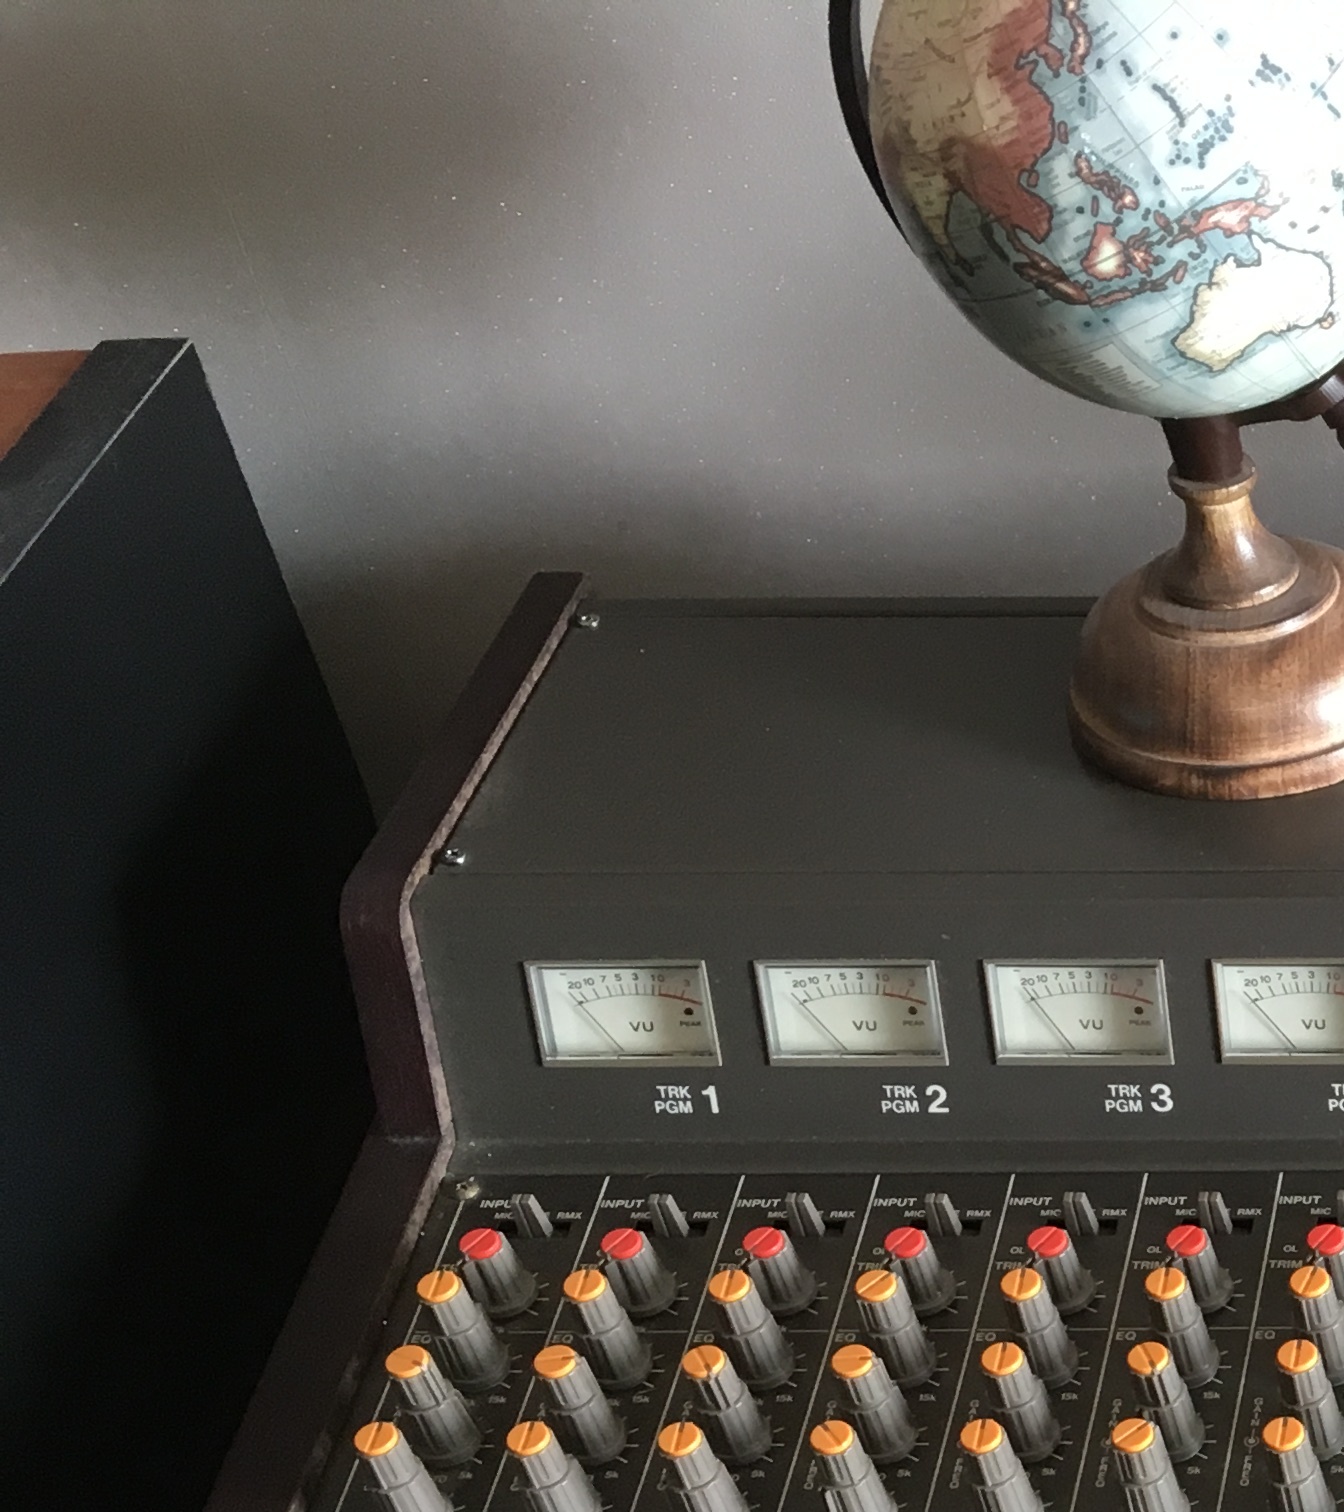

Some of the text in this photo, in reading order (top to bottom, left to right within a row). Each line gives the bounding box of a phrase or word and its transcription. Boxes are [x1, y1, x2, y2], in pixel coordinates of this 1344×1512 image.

[630, 1021, 654, 1032] VU
[853, 1020, 877, 1031] VU
[1079, 1019, 1104, 1030] VU
[1302, 1019, 1326, 1030] VU
[656, 1086, 691, 1098] TRK
[883, 1085, 917, 1098] TRK
[1108, 1085, 1141, 1097] TRK
[702, 1086, 719, 1113] 1
[926, 1085, 949, 1113] 2
[1151, 1084, 1173, 1112] 3
[655, 1101, 693, 1113] PGM
[882, 1100, 919, 1113] PGM
[1105, 1099, 1142, 1112] PGM
[1145, 1196, 1187, 1207] INPUT
[1279, 1195, 1321, 1206] INPUT
